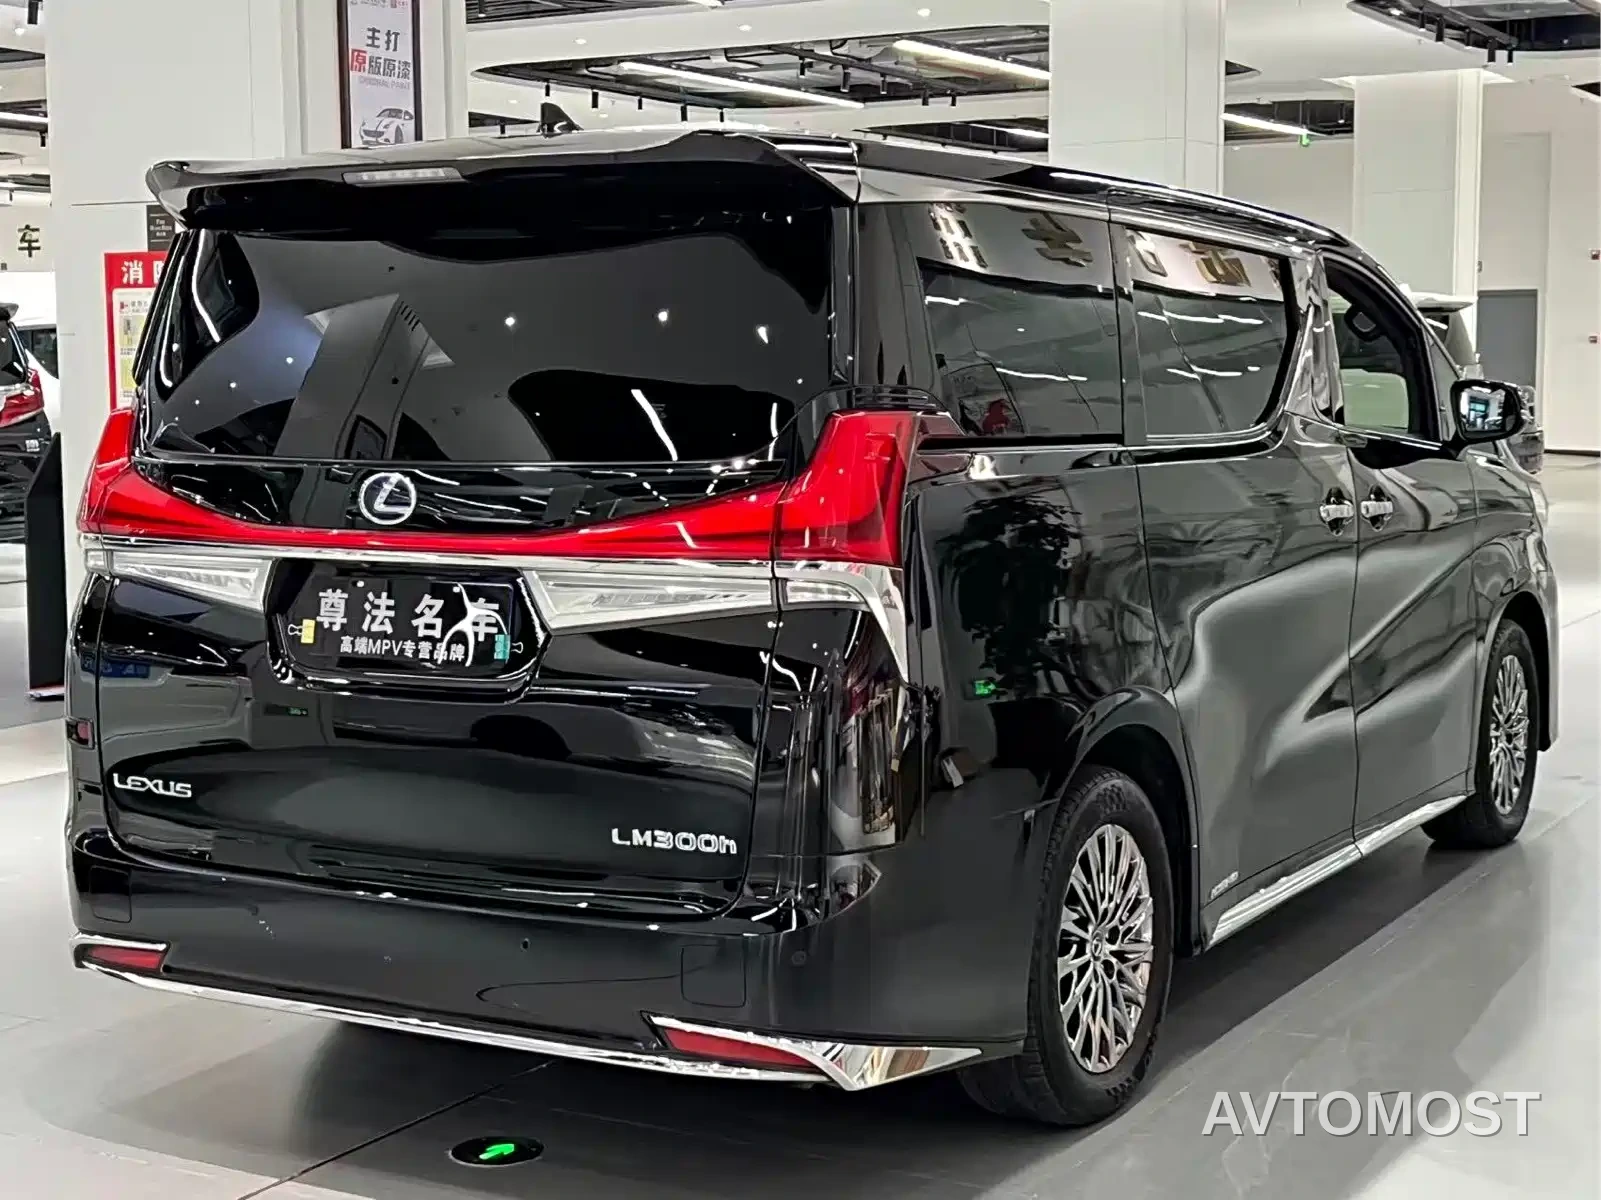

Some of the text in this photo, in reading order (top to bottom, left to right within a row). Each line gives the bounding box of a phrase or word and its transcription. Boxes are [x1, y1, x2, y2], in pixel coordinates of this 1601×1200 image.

[366, 27, 400, 52] 主打
[350, 48, 411, 80] 原版原漆
[17, 224, 41, 258] 车
[113, 772, 192, 798] LEXUS
[611, 828, 738, 854] LM300h
